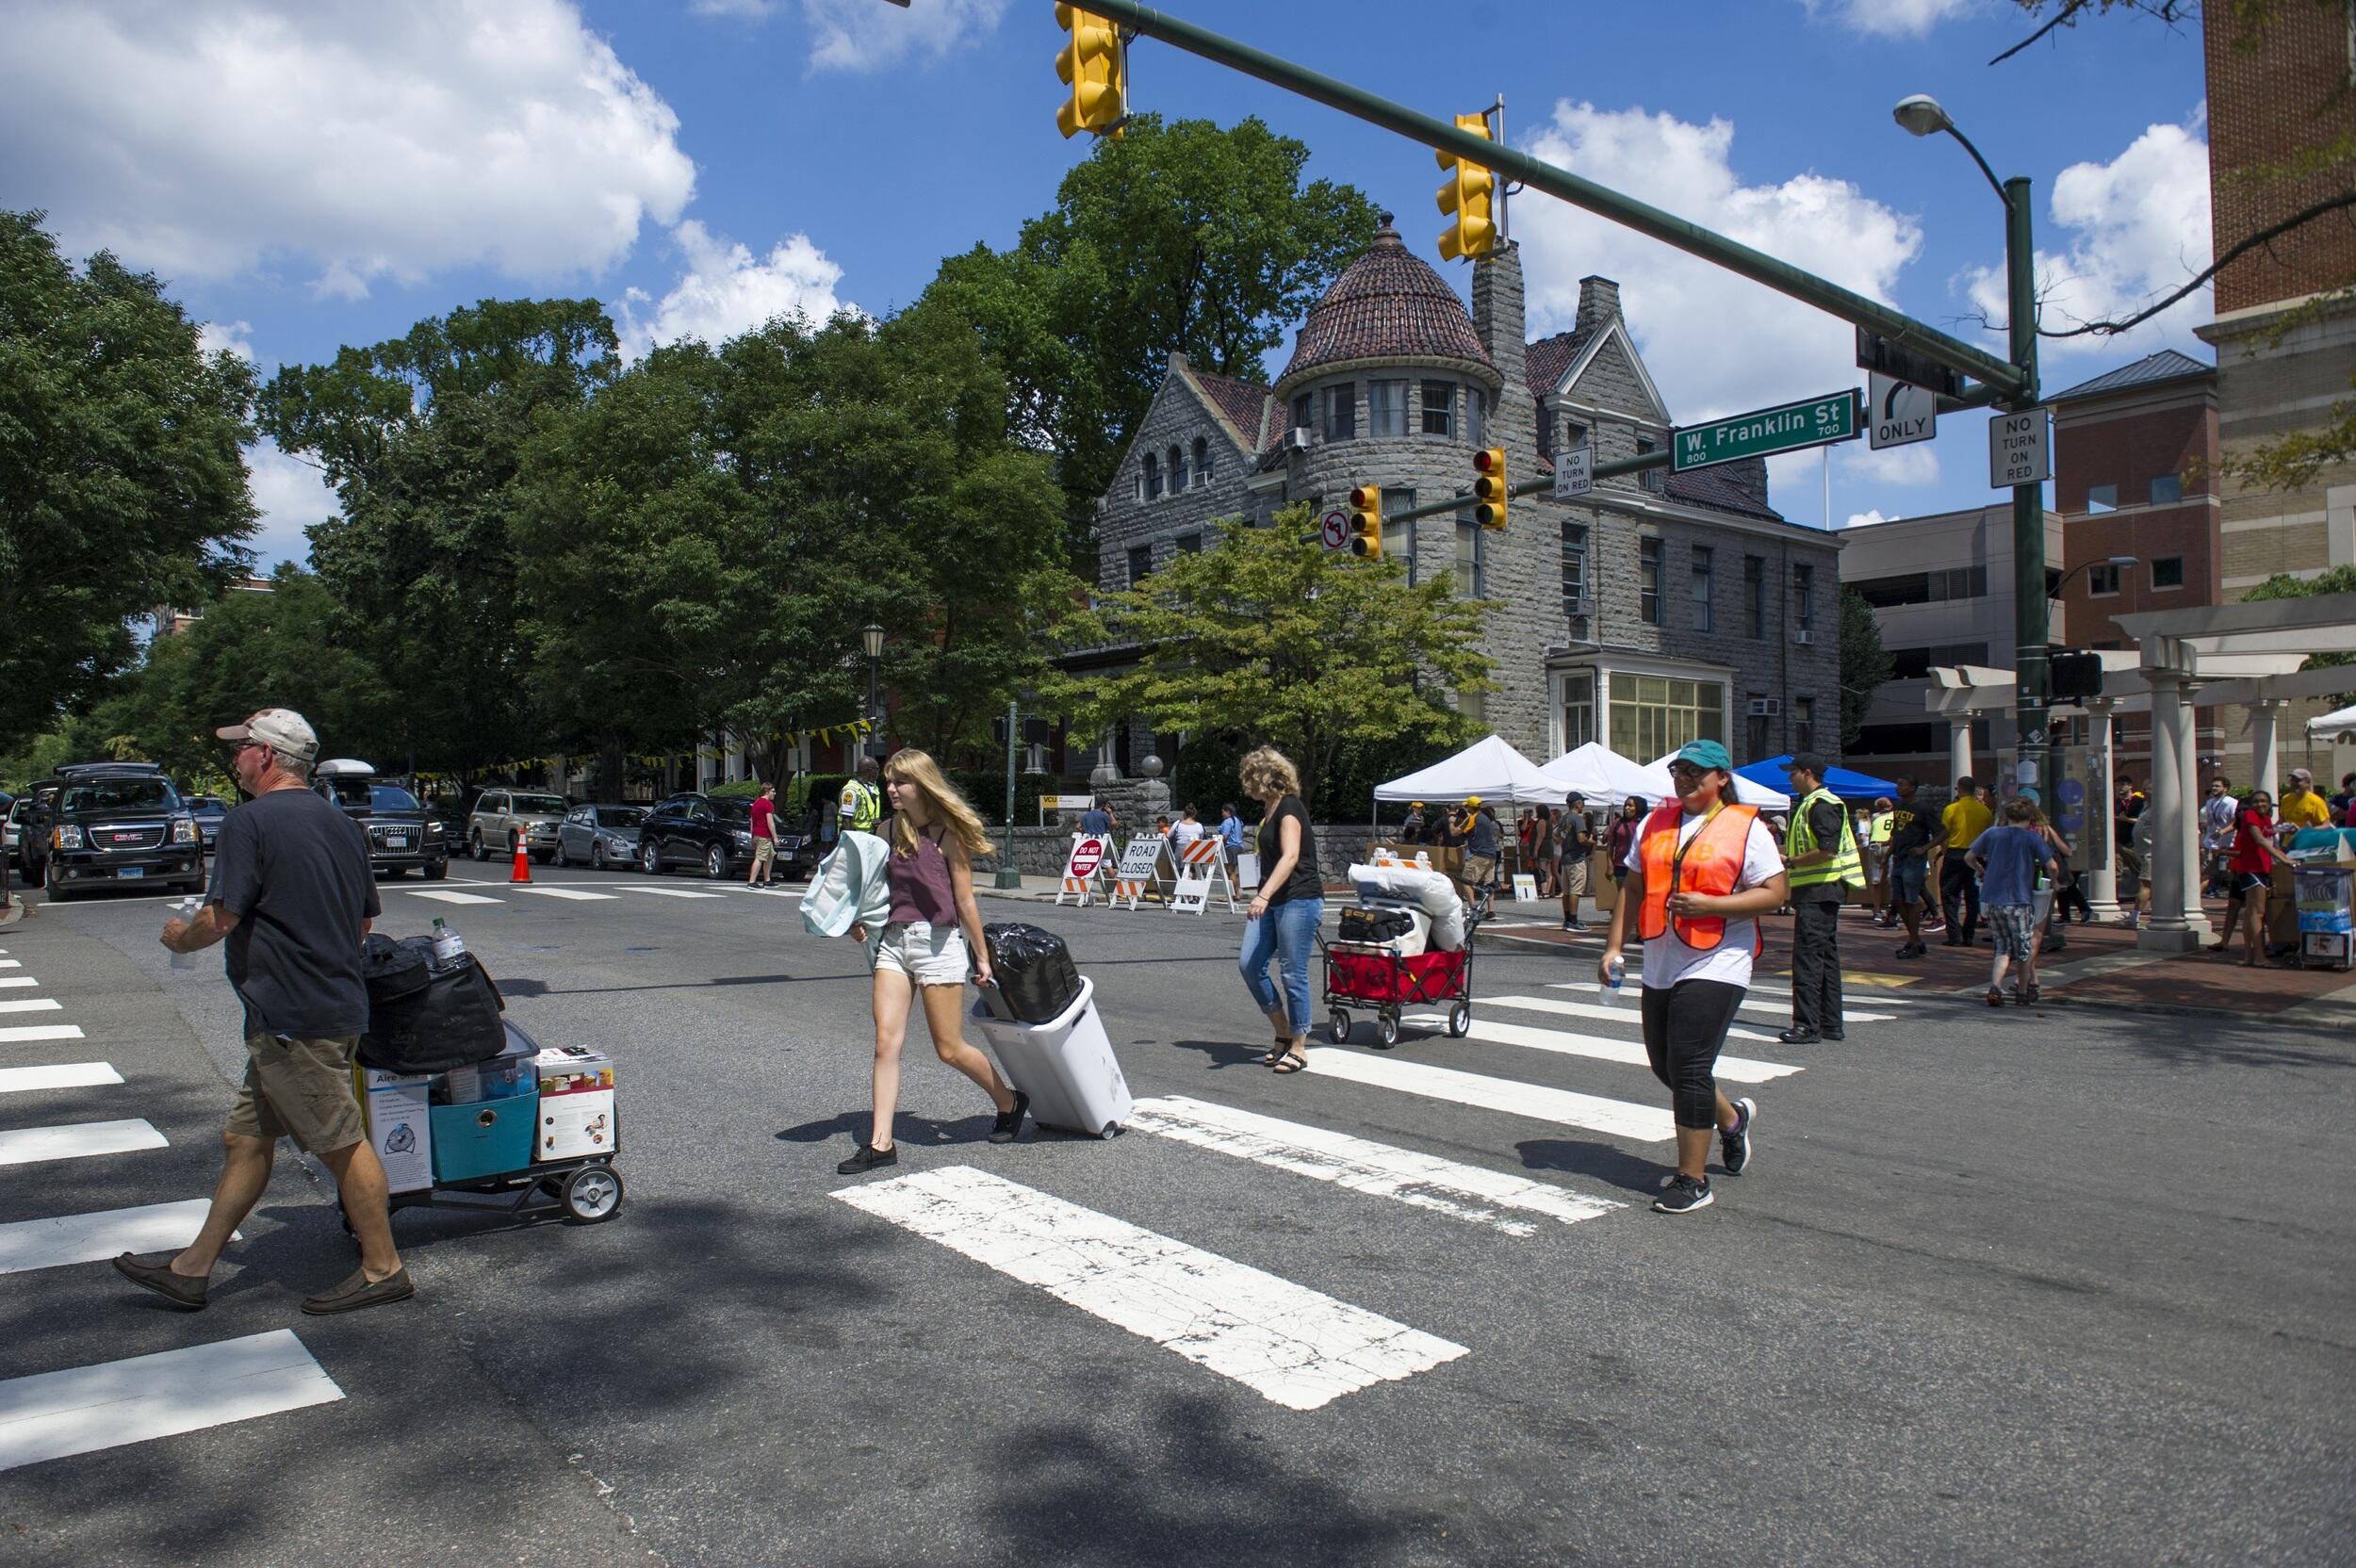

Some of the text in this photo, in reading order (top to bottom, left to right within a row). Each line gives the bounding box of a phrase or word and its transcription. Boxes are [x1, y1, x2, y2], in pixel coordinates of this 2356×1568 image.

[1686, 402, 1840, 452] W. Franklin St
[1817, 423, 1840, 436] 700
[1879, 417, 1926, 441] ONLY
[2006, 417, 2031, 434] NO
[2003, 434, 2037, 449] TURN
[1566, 456, 1579, 466] NO
[1686, 451, 1707, 464] 800
[2011, 451, 2028, 464] ON
[1562, 467, 1583, 479] TURN
[2007, 466, 2033, 480] RED
[1558, 480, 1588, 493] ON RED
[1129, 845, 1156, 858] ROAD
[1120, 862, 1153, 874] CLOSED
